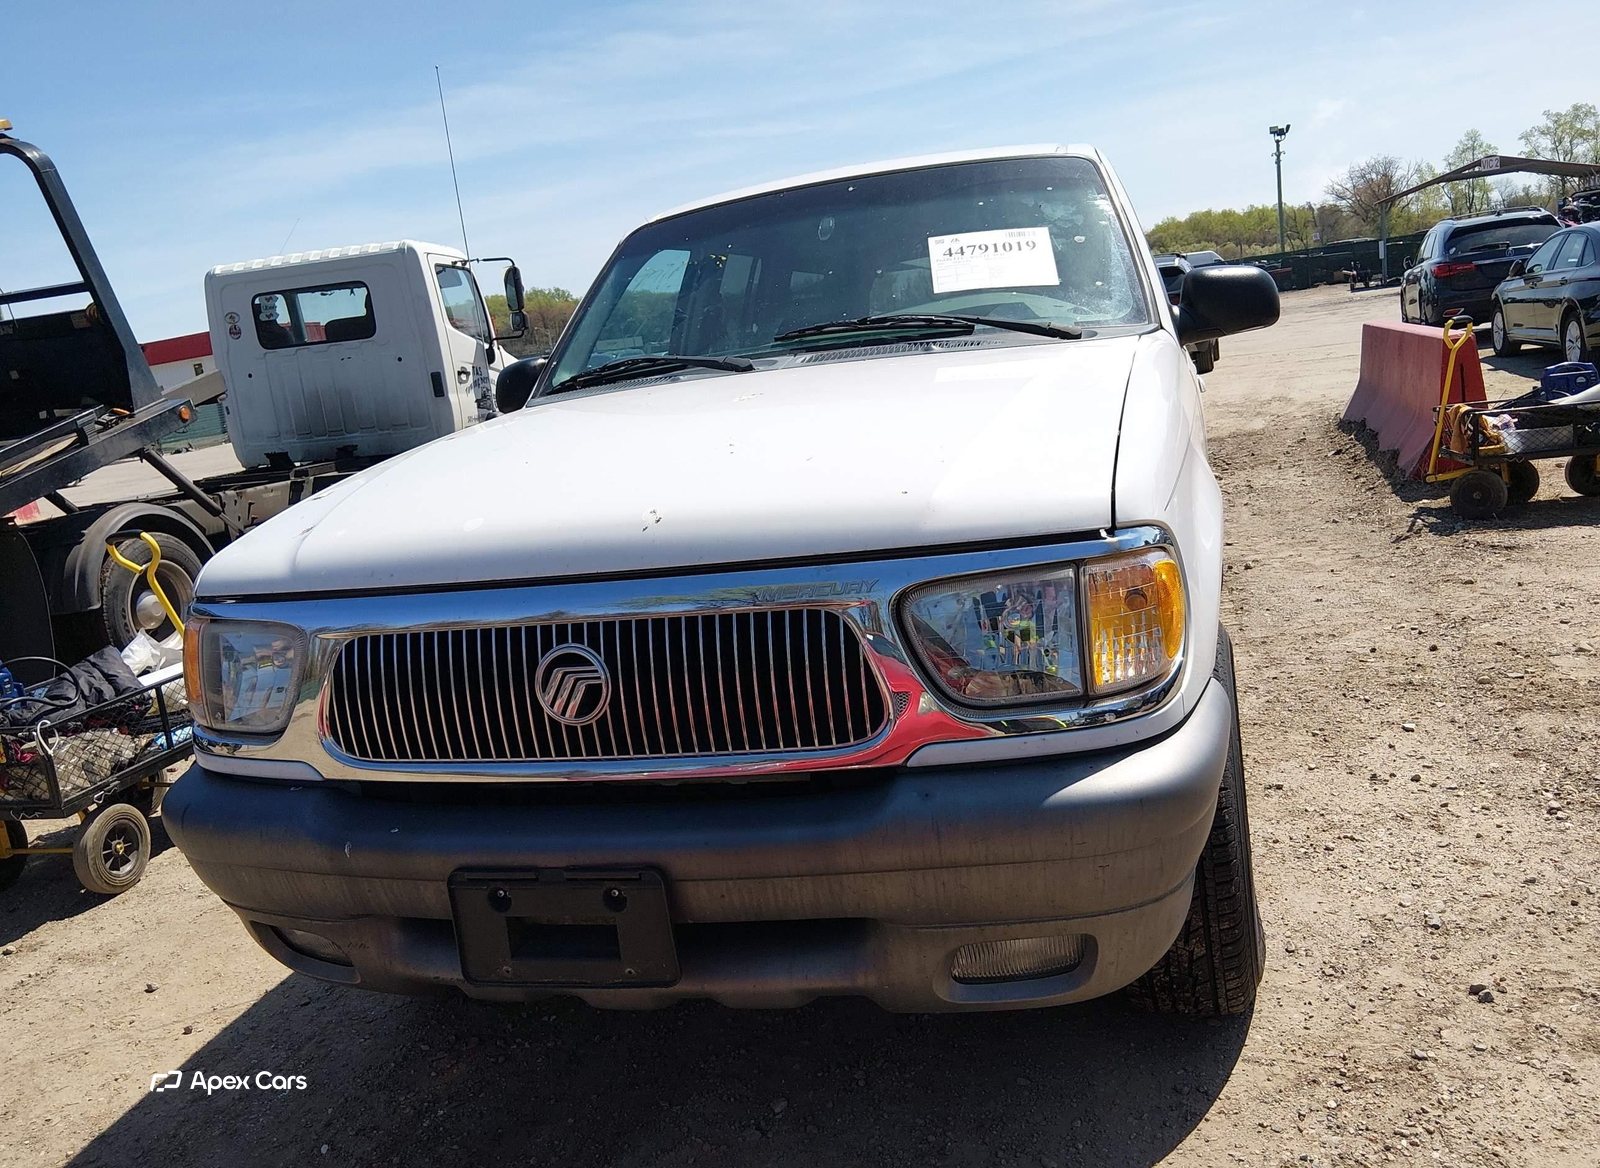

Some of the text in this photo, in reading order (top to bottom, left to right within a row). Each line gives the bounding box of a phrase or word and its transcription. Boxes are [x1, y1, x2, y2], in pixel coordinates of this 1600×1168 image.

[1481, 158, 1500, 169] VIC 2
[942, 239, 1037, 258] 44791019
[759, 578, 879, 600] MERCURY
